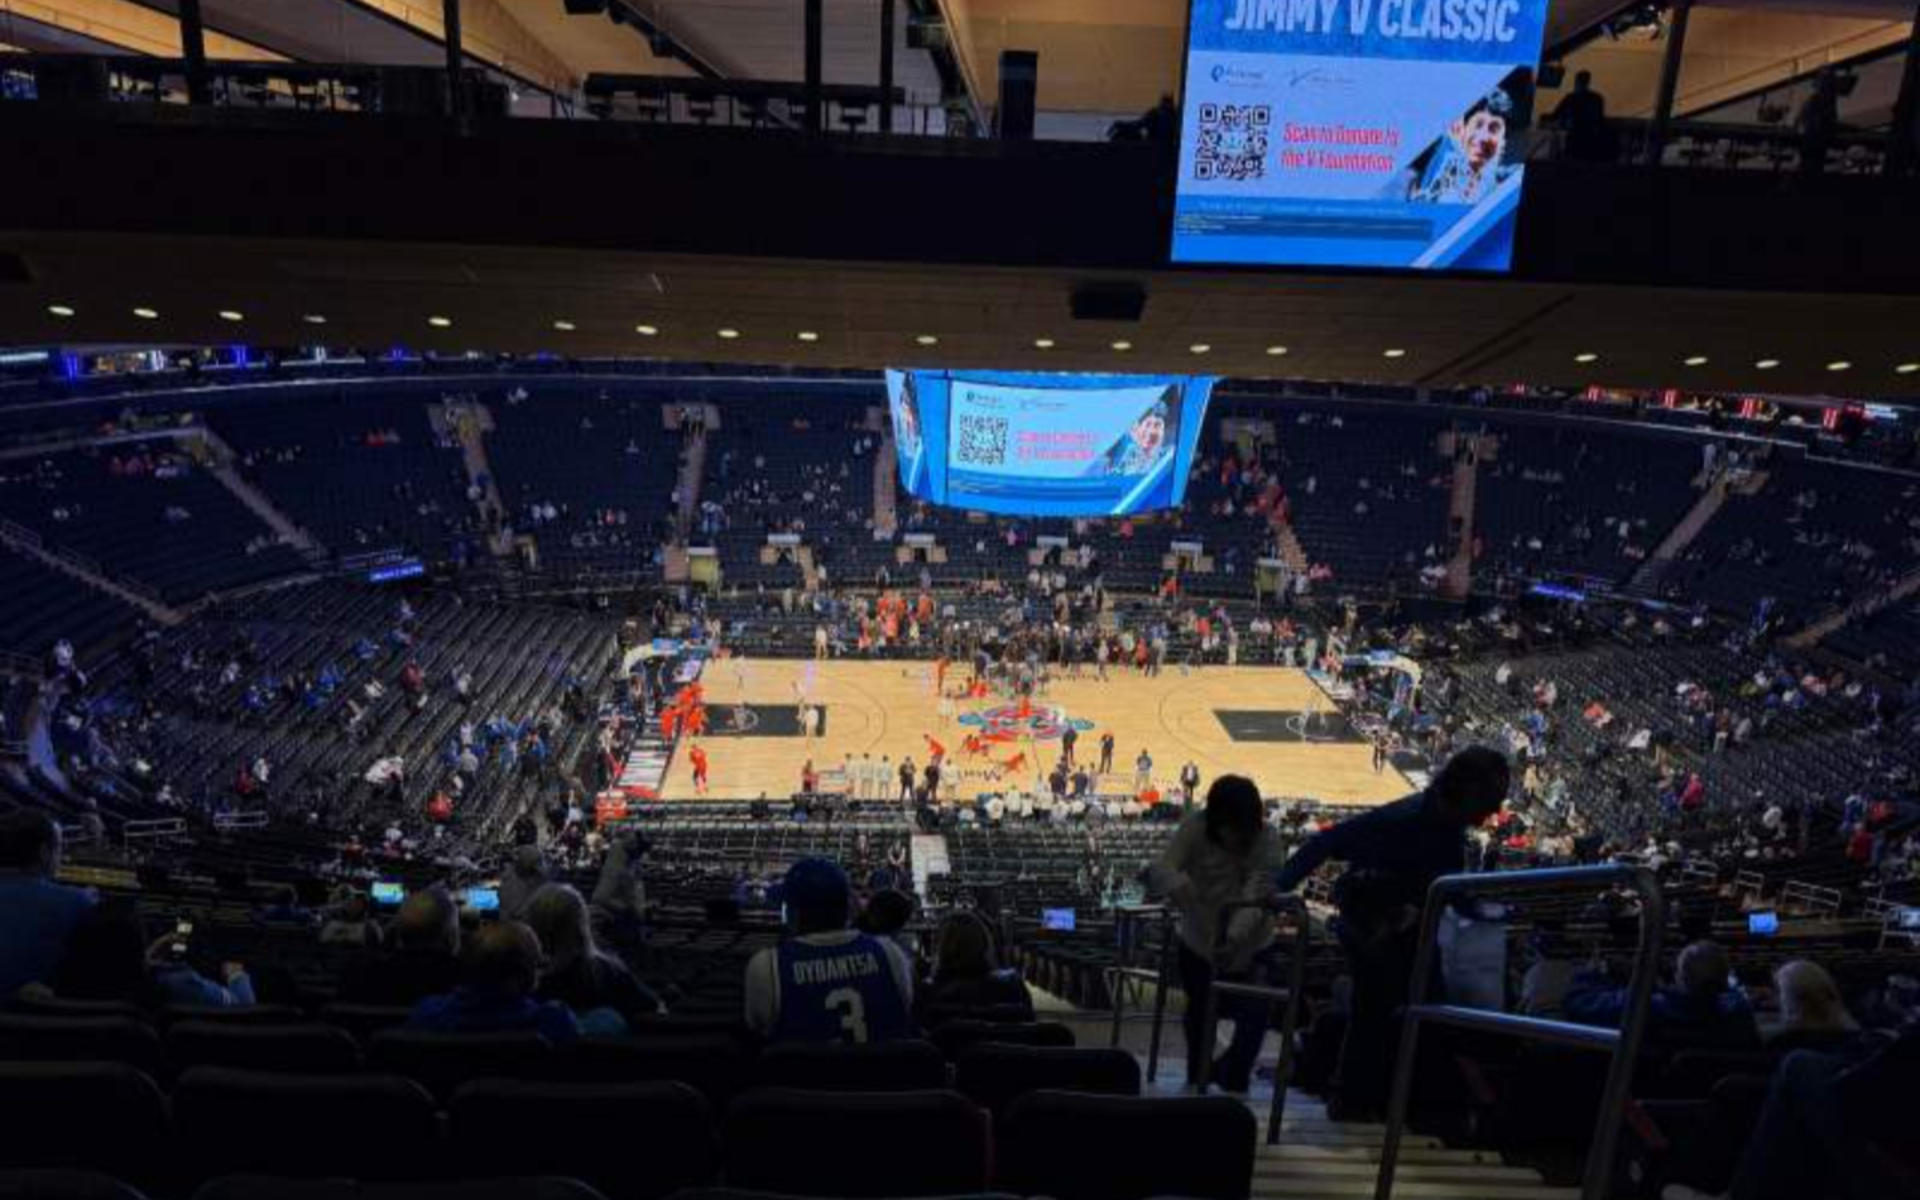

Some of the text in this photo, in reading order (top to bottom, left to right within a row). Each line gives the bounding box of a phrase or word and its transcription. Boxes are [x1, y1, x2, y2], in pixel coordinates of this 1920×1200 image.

[1224, 0, 1519, 43] JIMMY V CLASSIC
[1283, 121, 1317, 143] Scan
[824, 986, 868, 1043] 3
